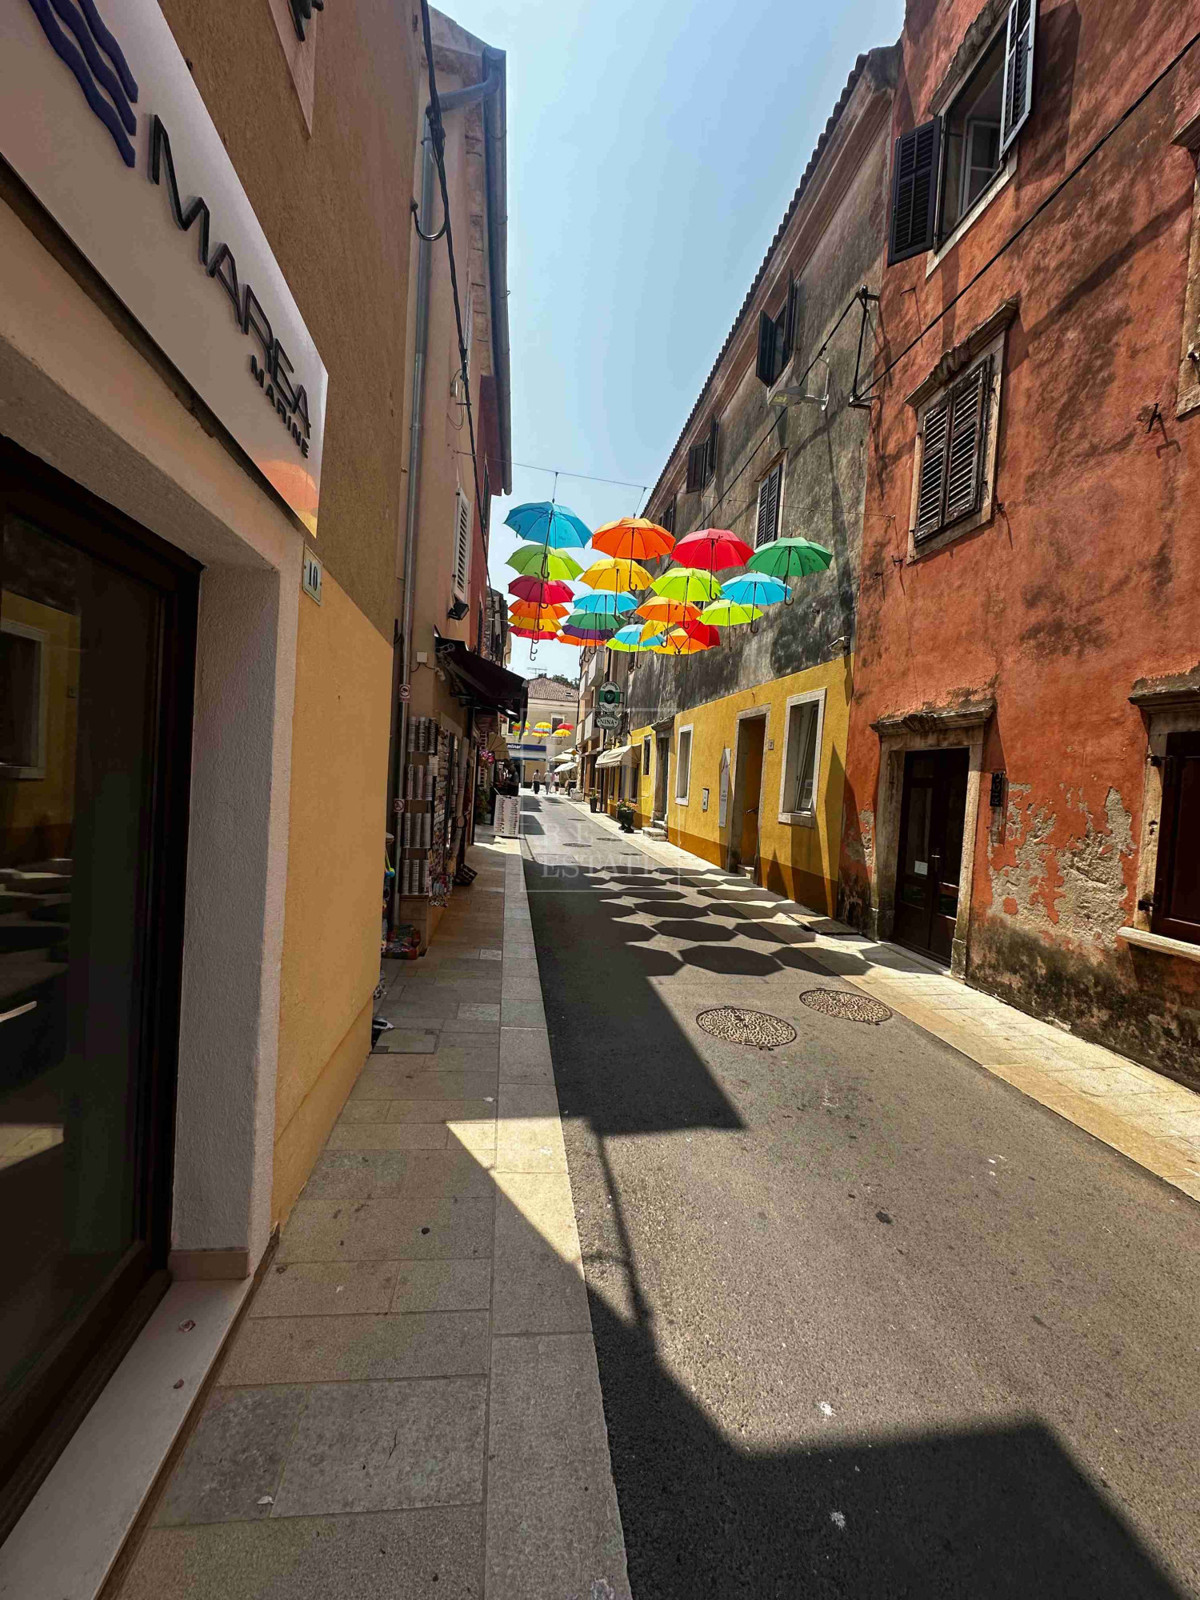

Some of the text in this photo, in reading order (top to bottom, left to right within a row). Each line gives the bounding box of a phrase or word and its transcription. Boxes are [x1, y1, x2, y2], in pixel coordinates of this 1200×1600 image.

[150, 113, 311, 440] MAREA
[250, 354, 309, 459] MARINE
[308, 561, 318, 592] 10
